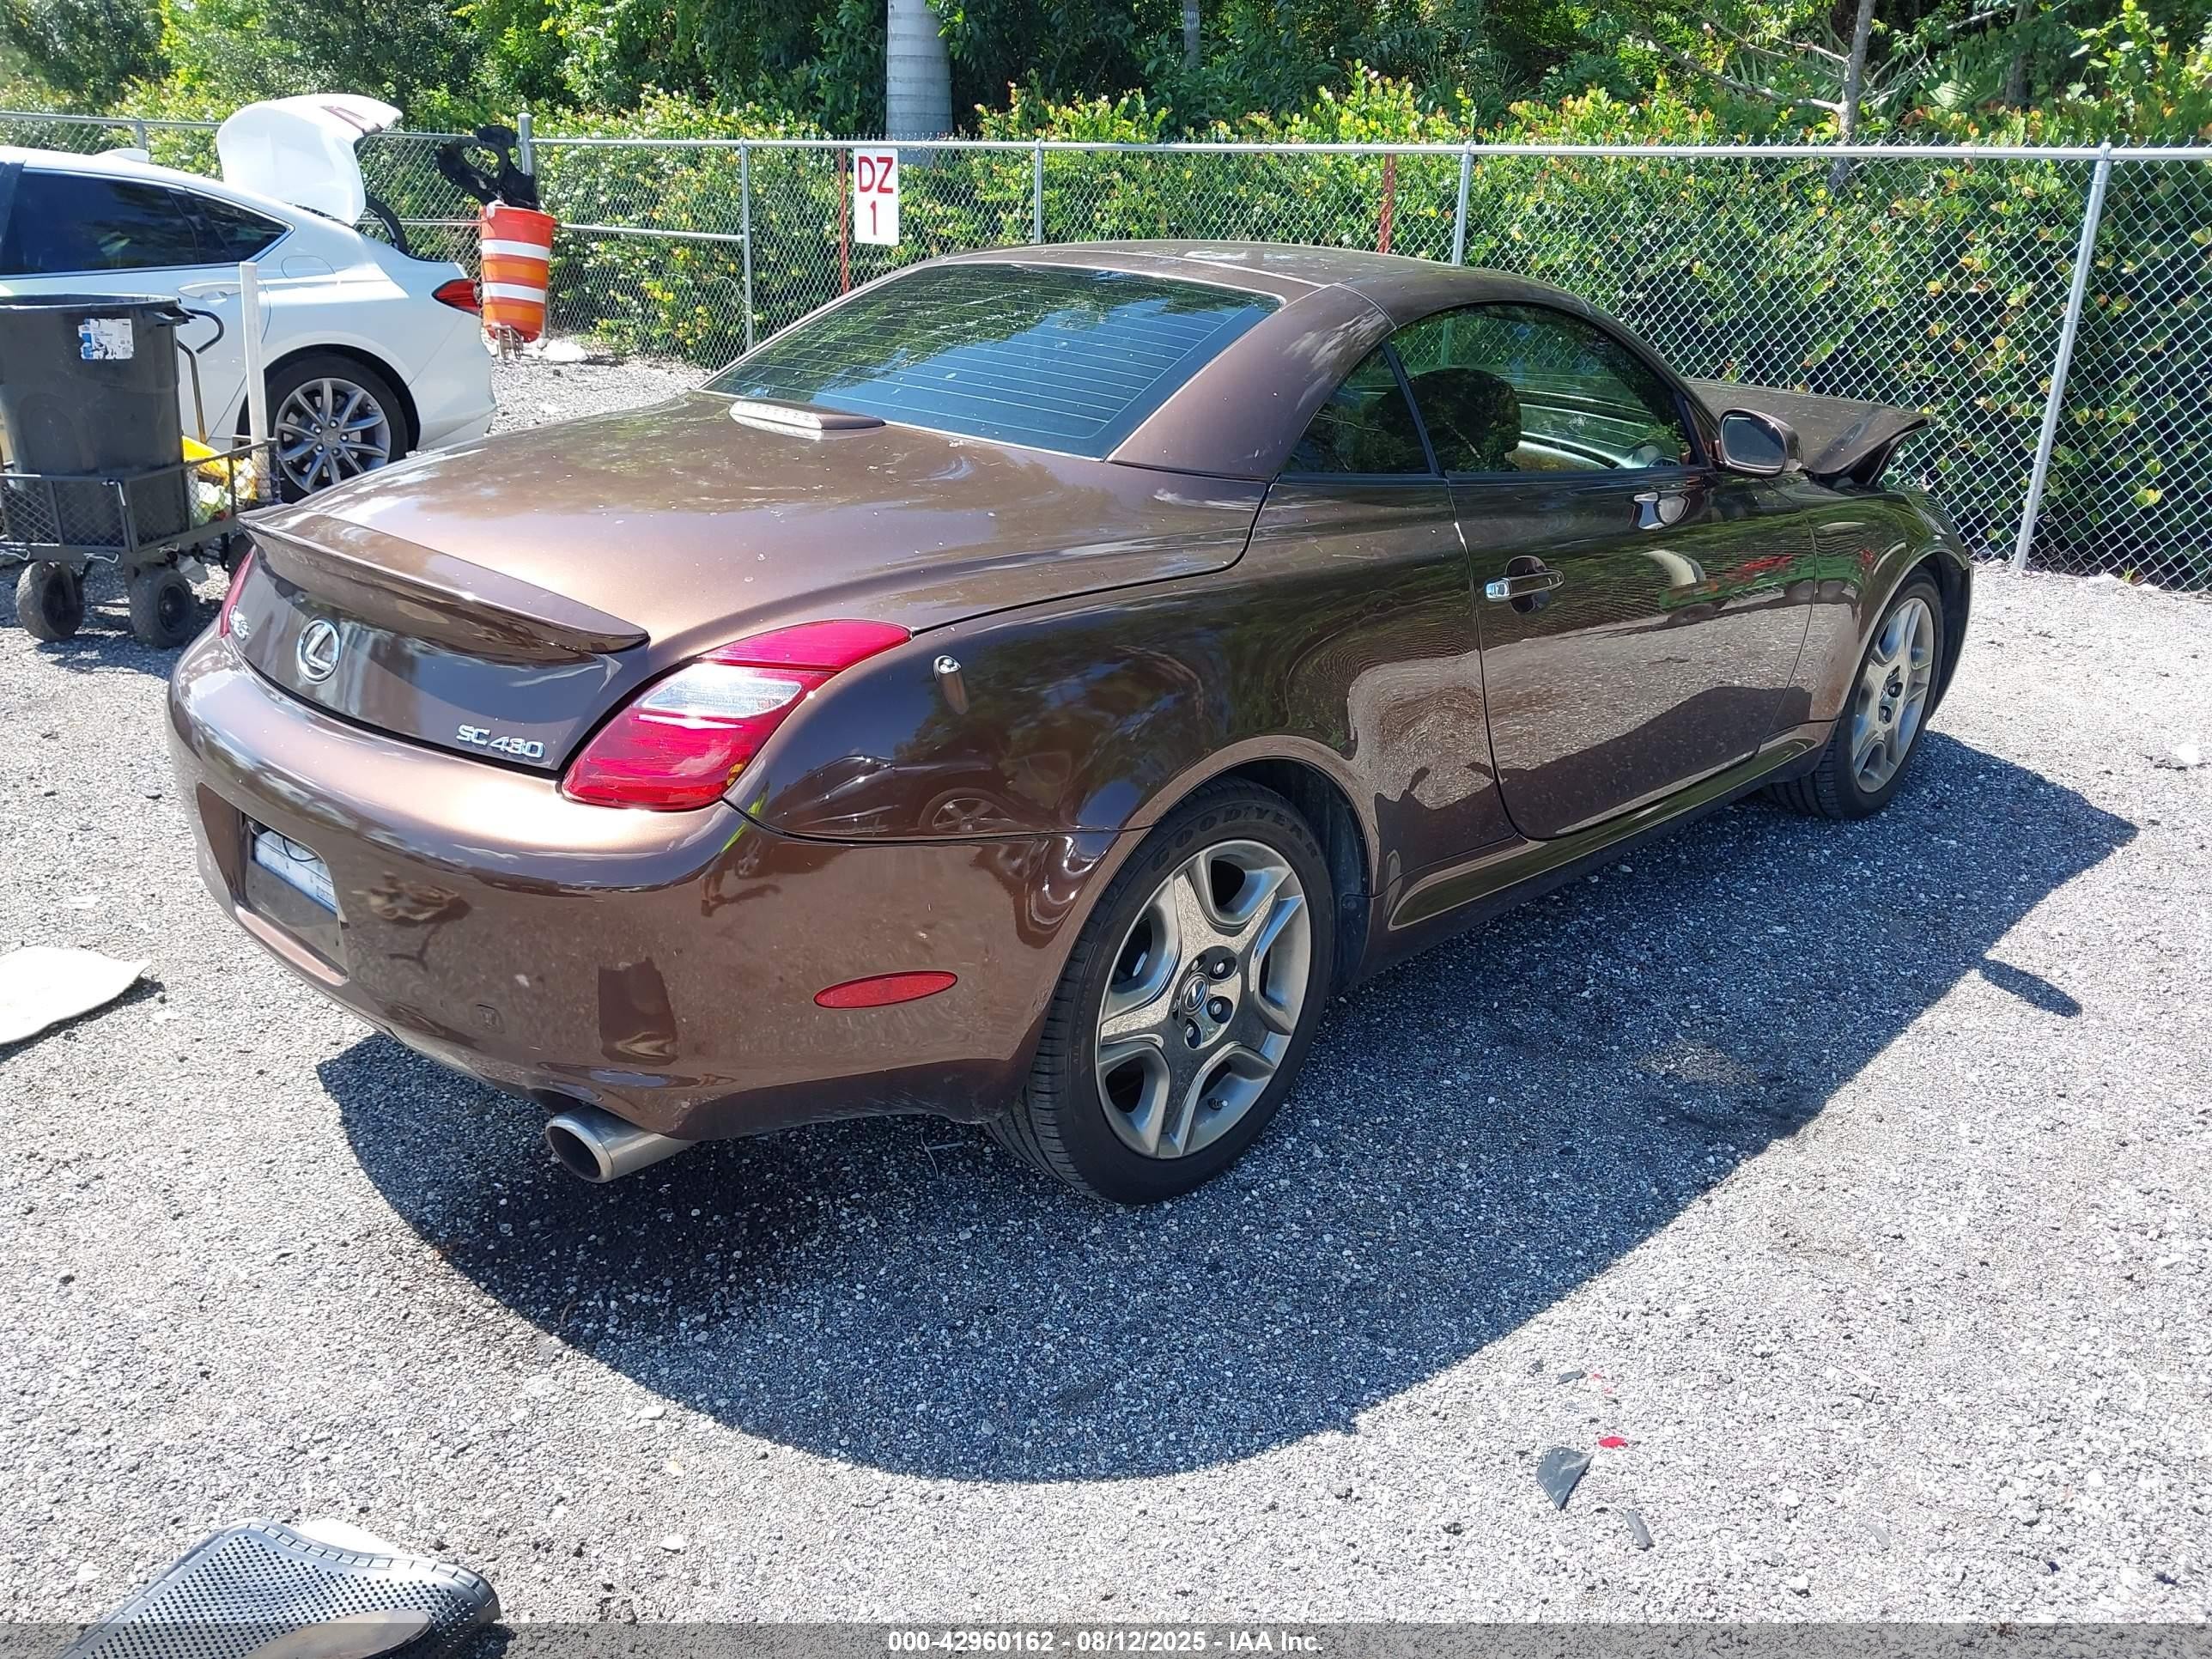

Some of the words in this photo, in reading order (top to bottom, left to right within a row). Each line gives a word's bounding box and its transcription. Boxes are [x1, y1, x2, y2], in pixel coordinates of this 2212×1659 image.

[858, 155, 894, 194] DZ
[869, 200, 878, 235] 1
[456, 725, 490, 746] SC
[489, 736, 545, 759] 430
[1152, 806, 1318, 872] GOODYEAR
